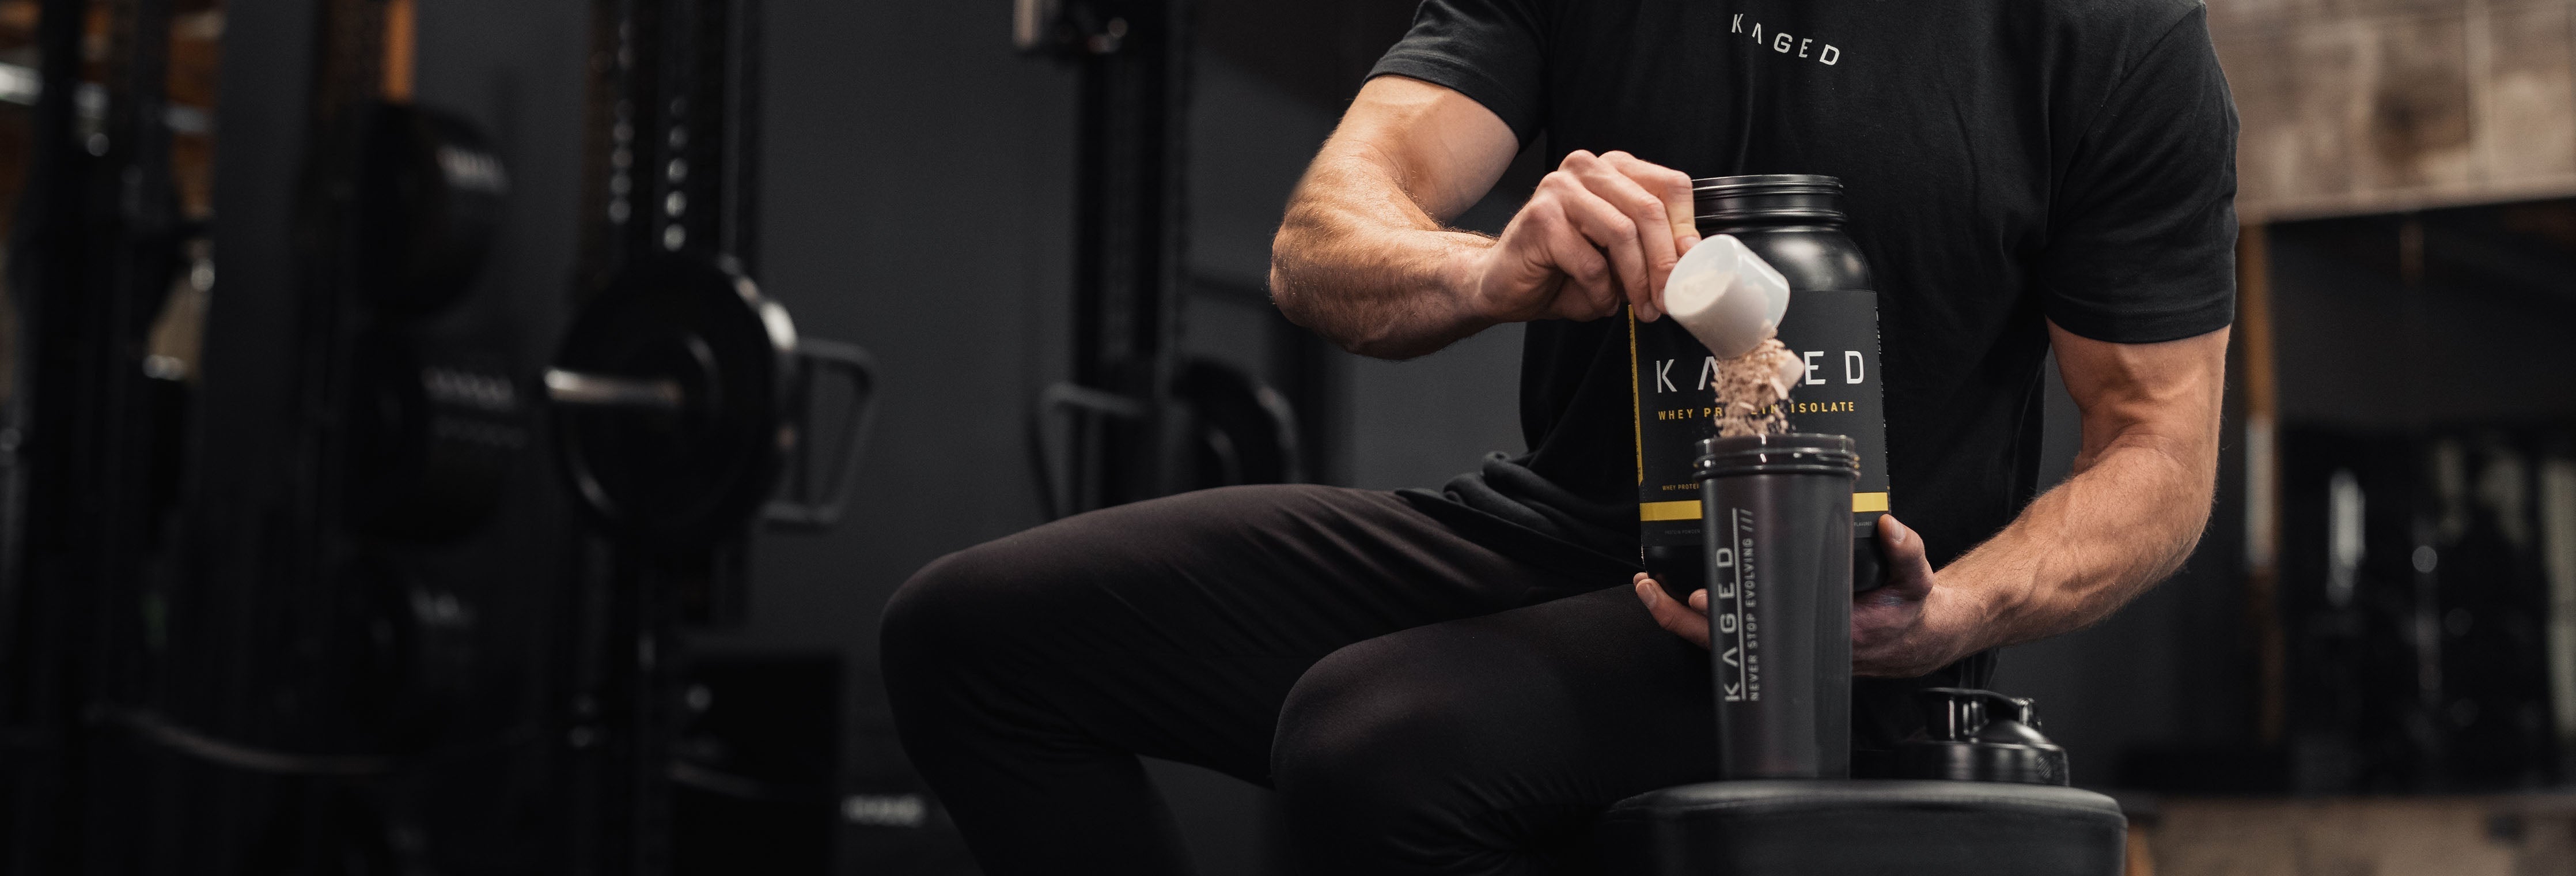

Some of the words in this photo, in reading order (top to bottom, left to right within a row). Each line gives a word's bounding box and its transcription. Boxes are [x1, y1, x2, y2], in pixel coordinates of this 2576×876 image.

[1731, 13, 1840, 66] KAGED
[1656, 350, 1864, 393] KAED
[1658, 409, 1693, 420] WHEY
[1703, 403, 1781, 418] PRIN
[1791, 402, 1855, 413] ISOLATE
[1742, 538, 1757, 607] EVOLVING
[1717, 548, 1741, 701] KAGED
[1746, 613, 1757, 650] STOP
[1748, 654, 1760, 701] NEVER
